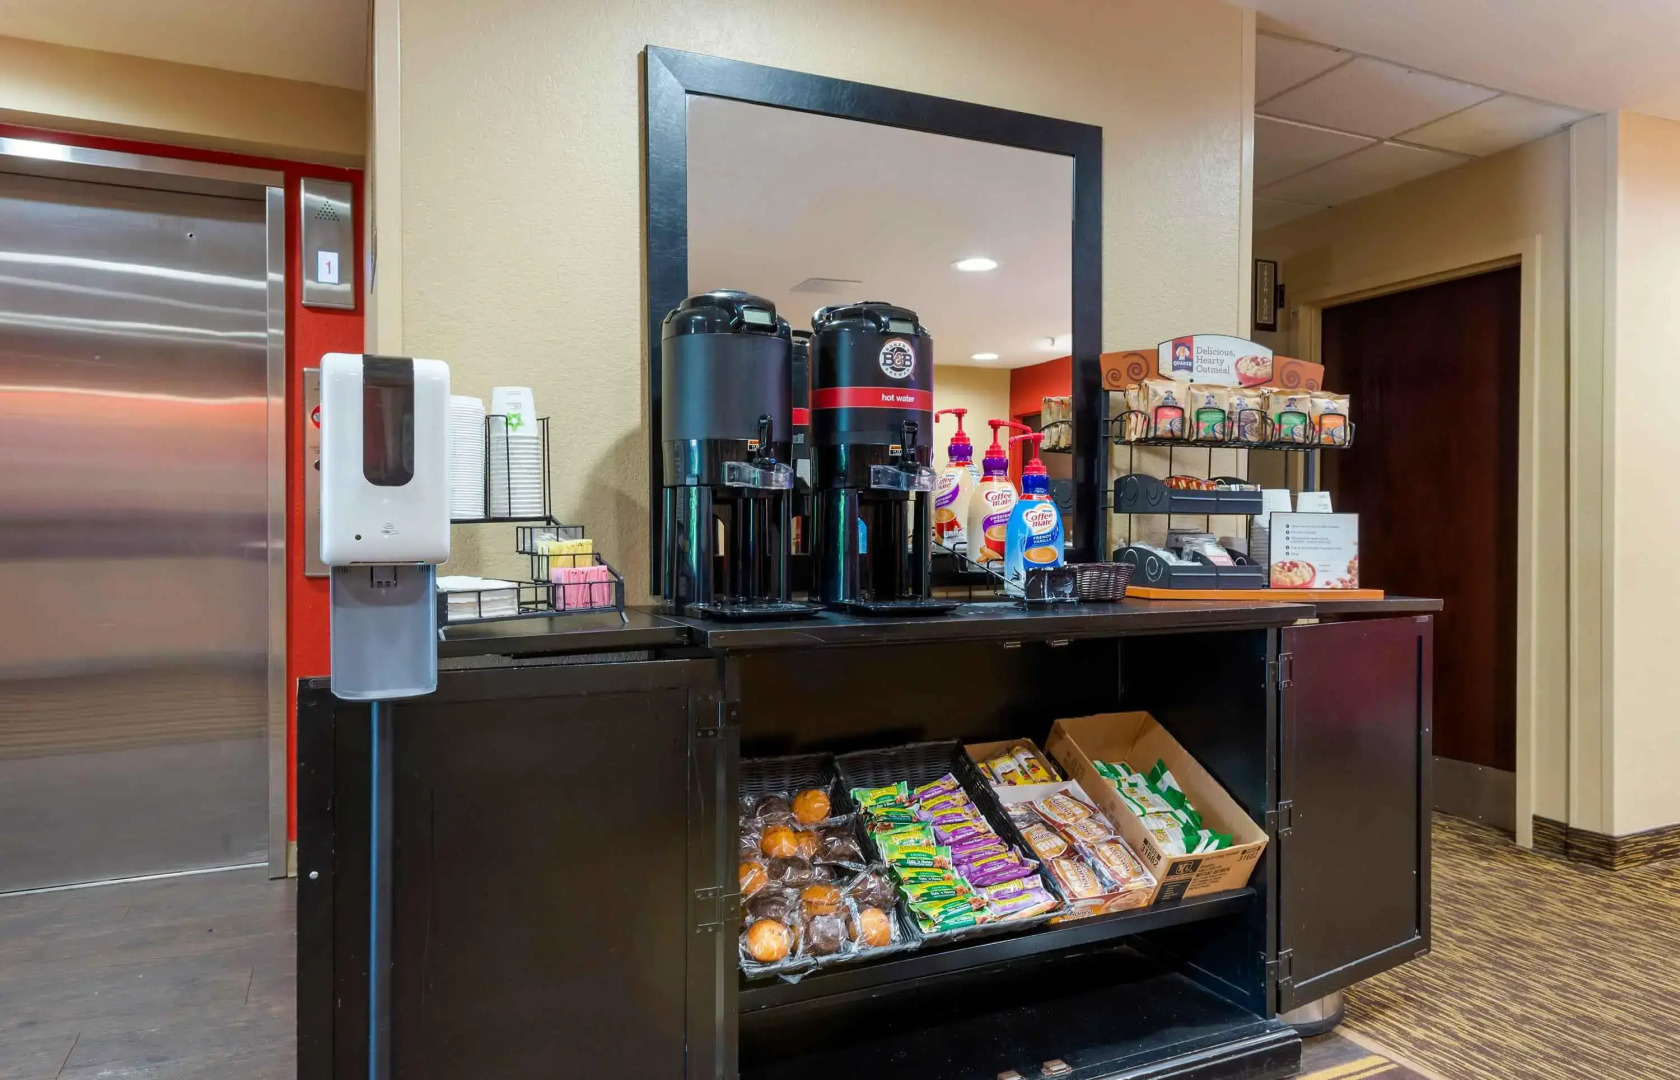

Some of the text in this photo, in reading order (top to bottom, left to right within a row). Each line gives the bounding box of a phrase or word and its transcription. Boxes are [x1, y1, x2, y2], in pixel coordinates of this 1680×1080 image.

[325, 260, 332, 275] 1
[1196, 346, 1236, 357] Delicious,
[882, 351, 913, 368] B&B
[1196, 355, 1225, 366] Hearty
[1195, 365, 1230, 375] Oatmeal
[881, 393, 915, 403] hot water
[985, 490, 1013, 503] Coffee
[992, 498, 1012, 507] mate
[1025, 510, 1053, 523] Coffee
[1032, 520, 1053, 528] mate
[1140, 844, 1159, 868] 31682
[1073, 862, 1091, 890] Honey
